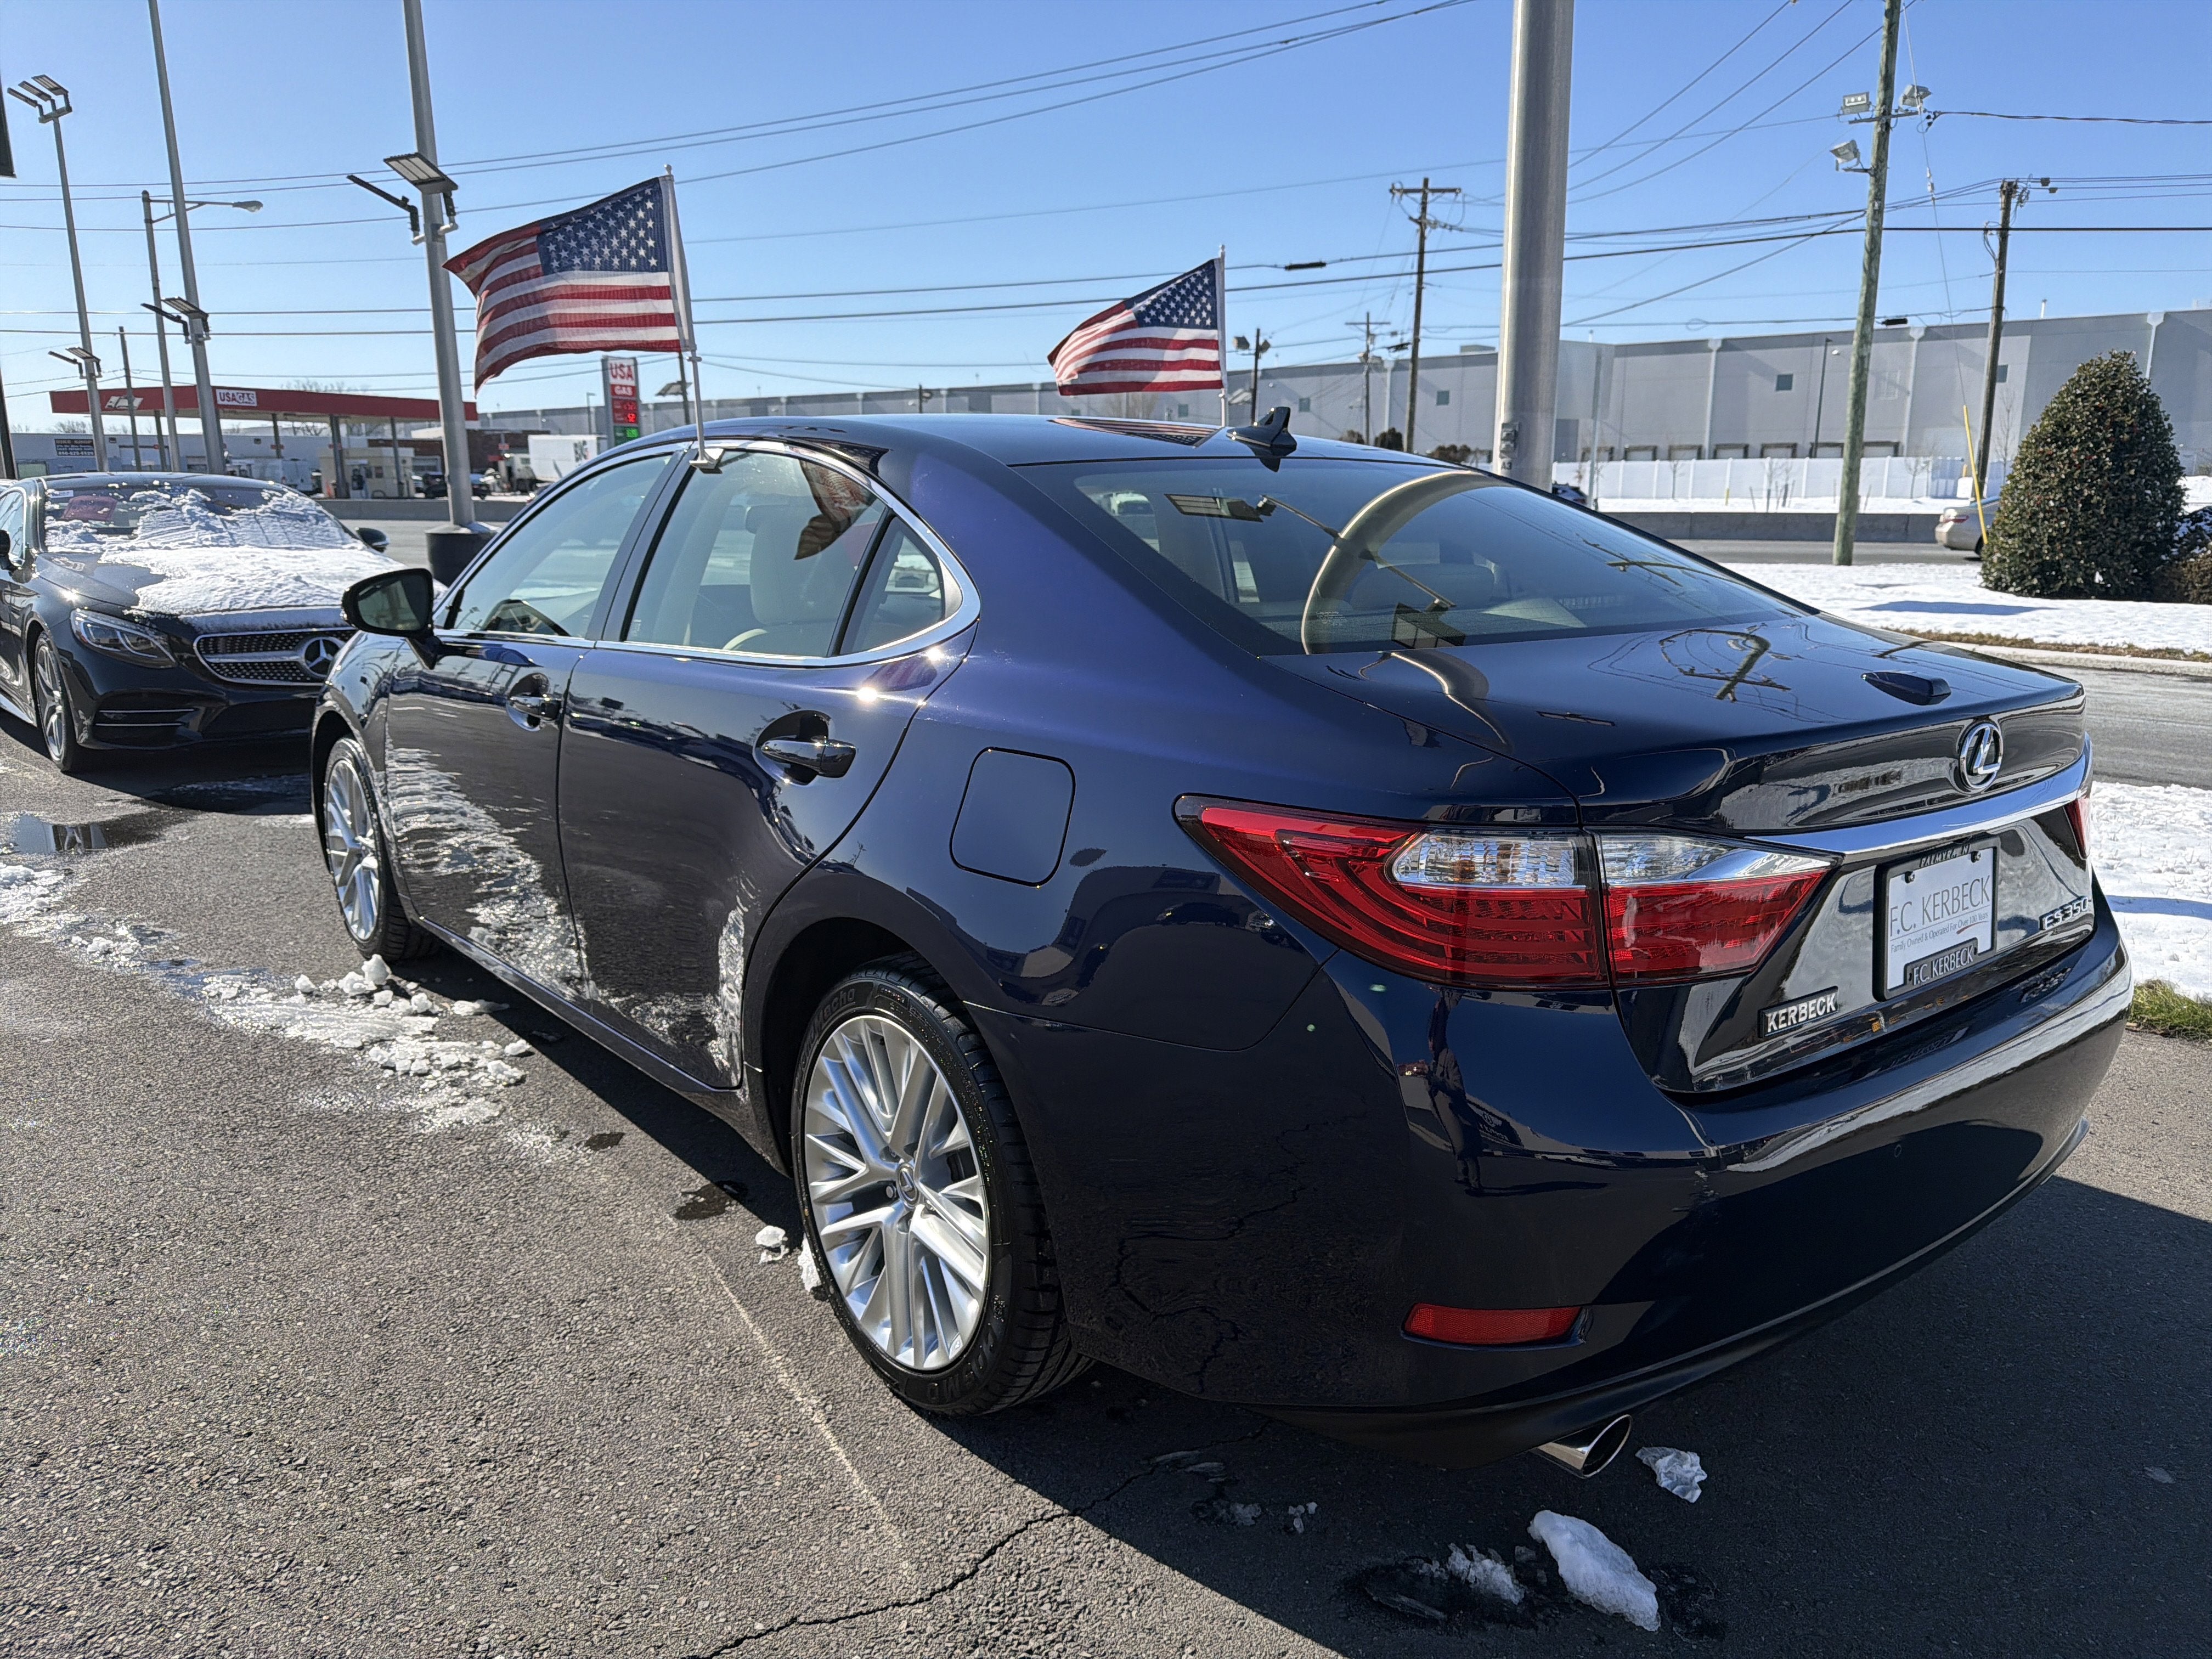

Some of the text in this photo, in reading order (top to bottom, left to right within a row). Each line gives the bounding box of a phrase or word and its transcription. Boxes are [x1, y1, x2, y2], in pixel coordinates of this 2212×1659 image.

[610, 363, 634, 380] USA
[614, 386, 633, 396] GAS
[1890, 875, 1990, 936] F.C. KERBECK
[1891, 940, 1906, 953] Family
[1907, 934, 1923, 947] Owned
[1929, 926, 1949, 941] Operated
[1957, 919, 1968, 928] Over
[1977, 911, 1989, 920] Years
[1913, 945, 1973, 986] F.C. KERBECK
[1765, 993, 1836, 1032] KERBECK
